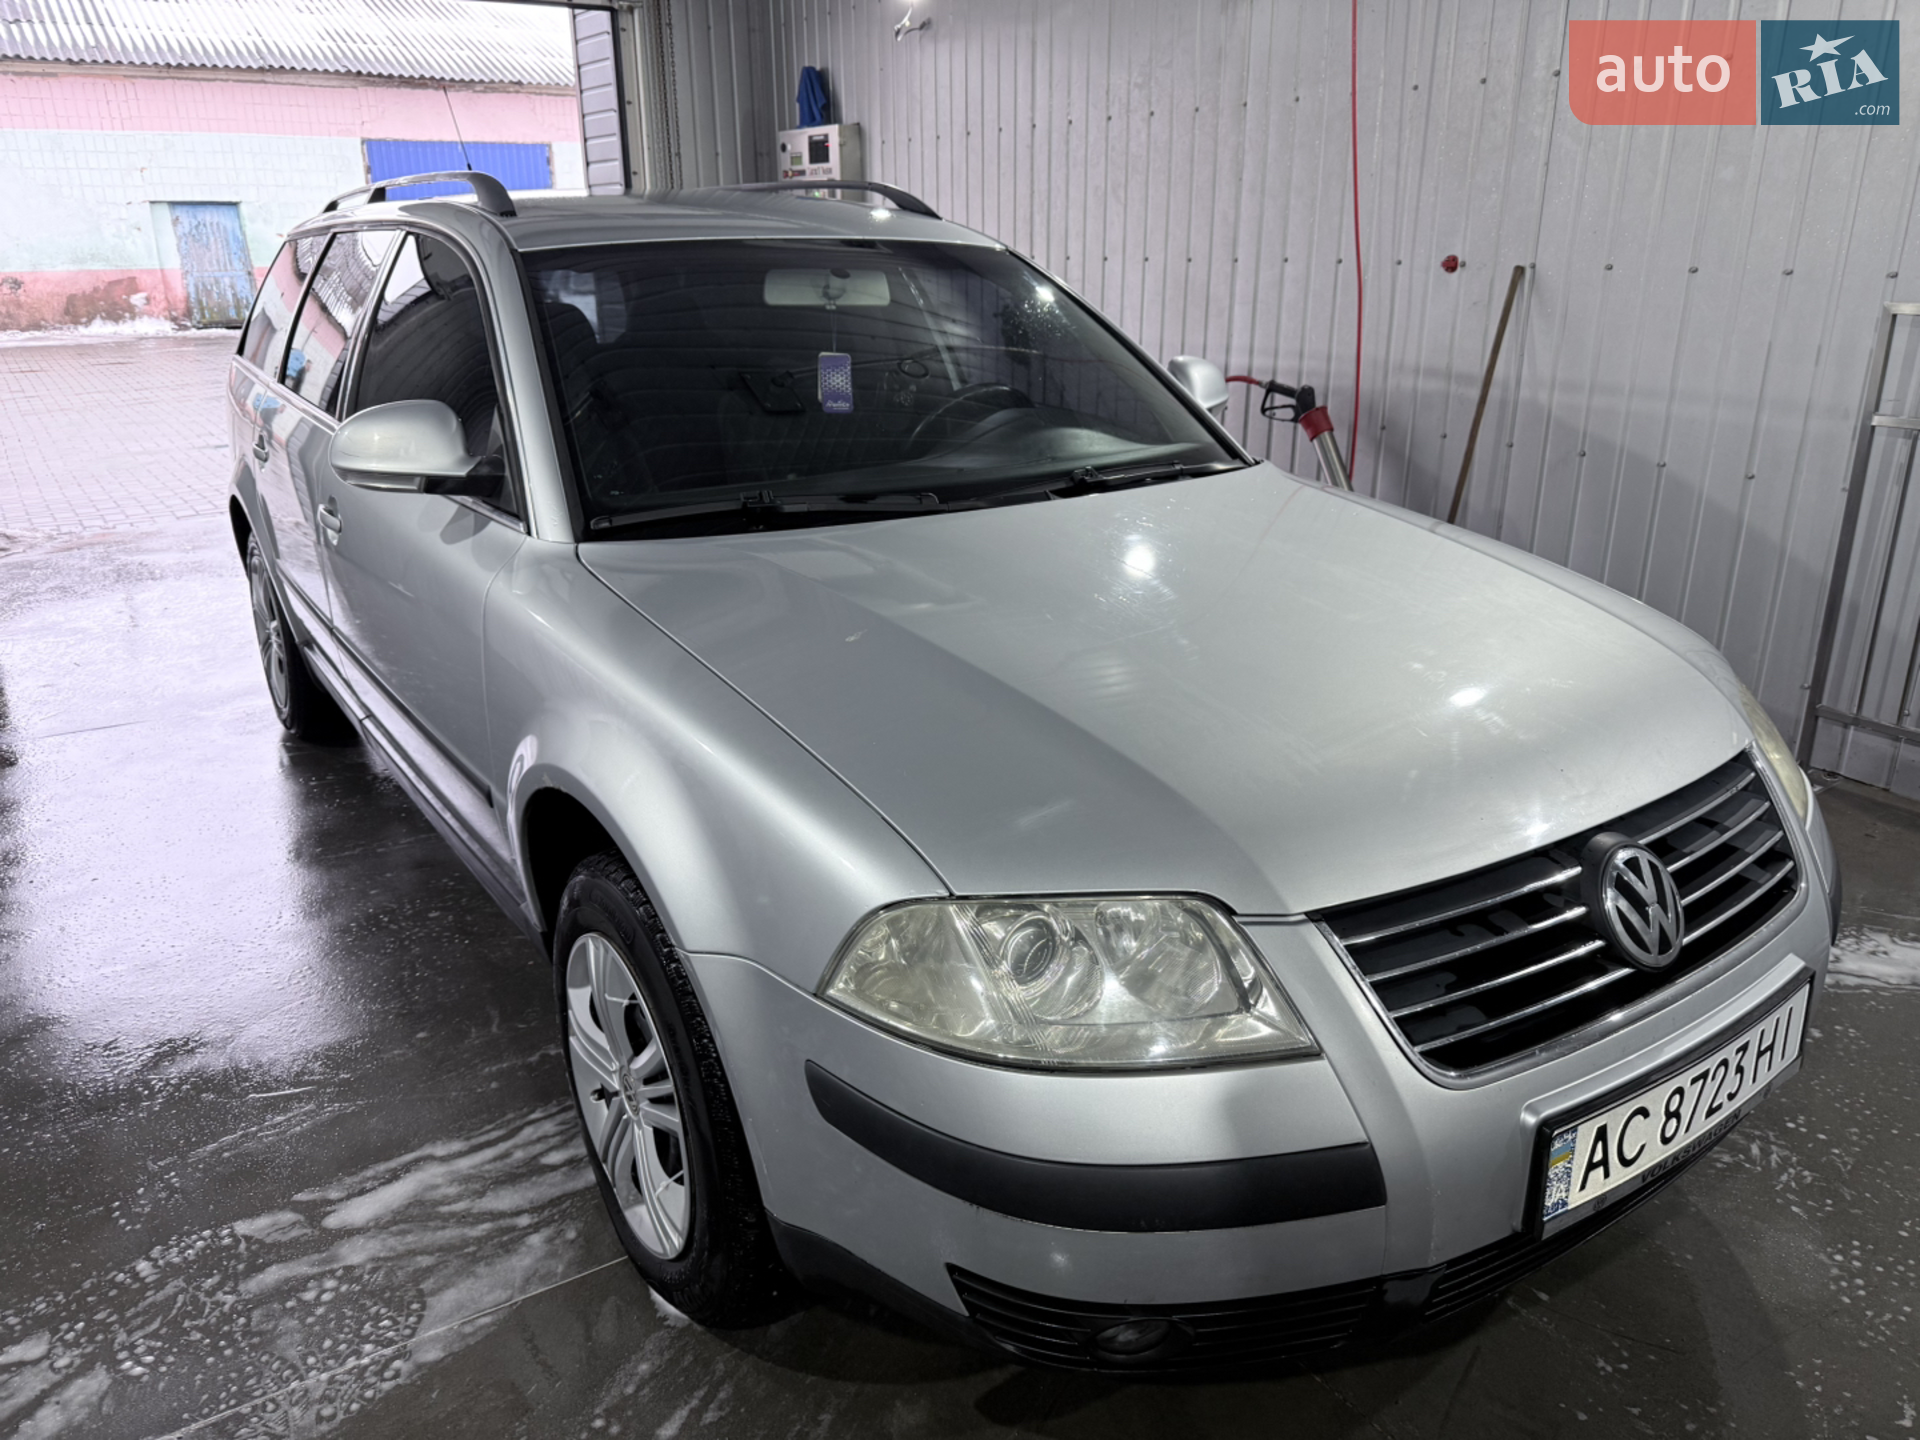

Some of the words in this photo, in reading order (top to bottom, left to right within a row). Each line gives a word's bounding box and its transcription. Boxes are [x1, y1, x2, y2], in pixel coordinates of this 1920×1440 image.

[1578, 1105, 1650, 1193] AC
[1659, 1038, 1750, 1146] 8723
[1750, 1005, 1794, 1085] HI
[1641, 1108, 1742, 1184] VOLKSWAGEN
